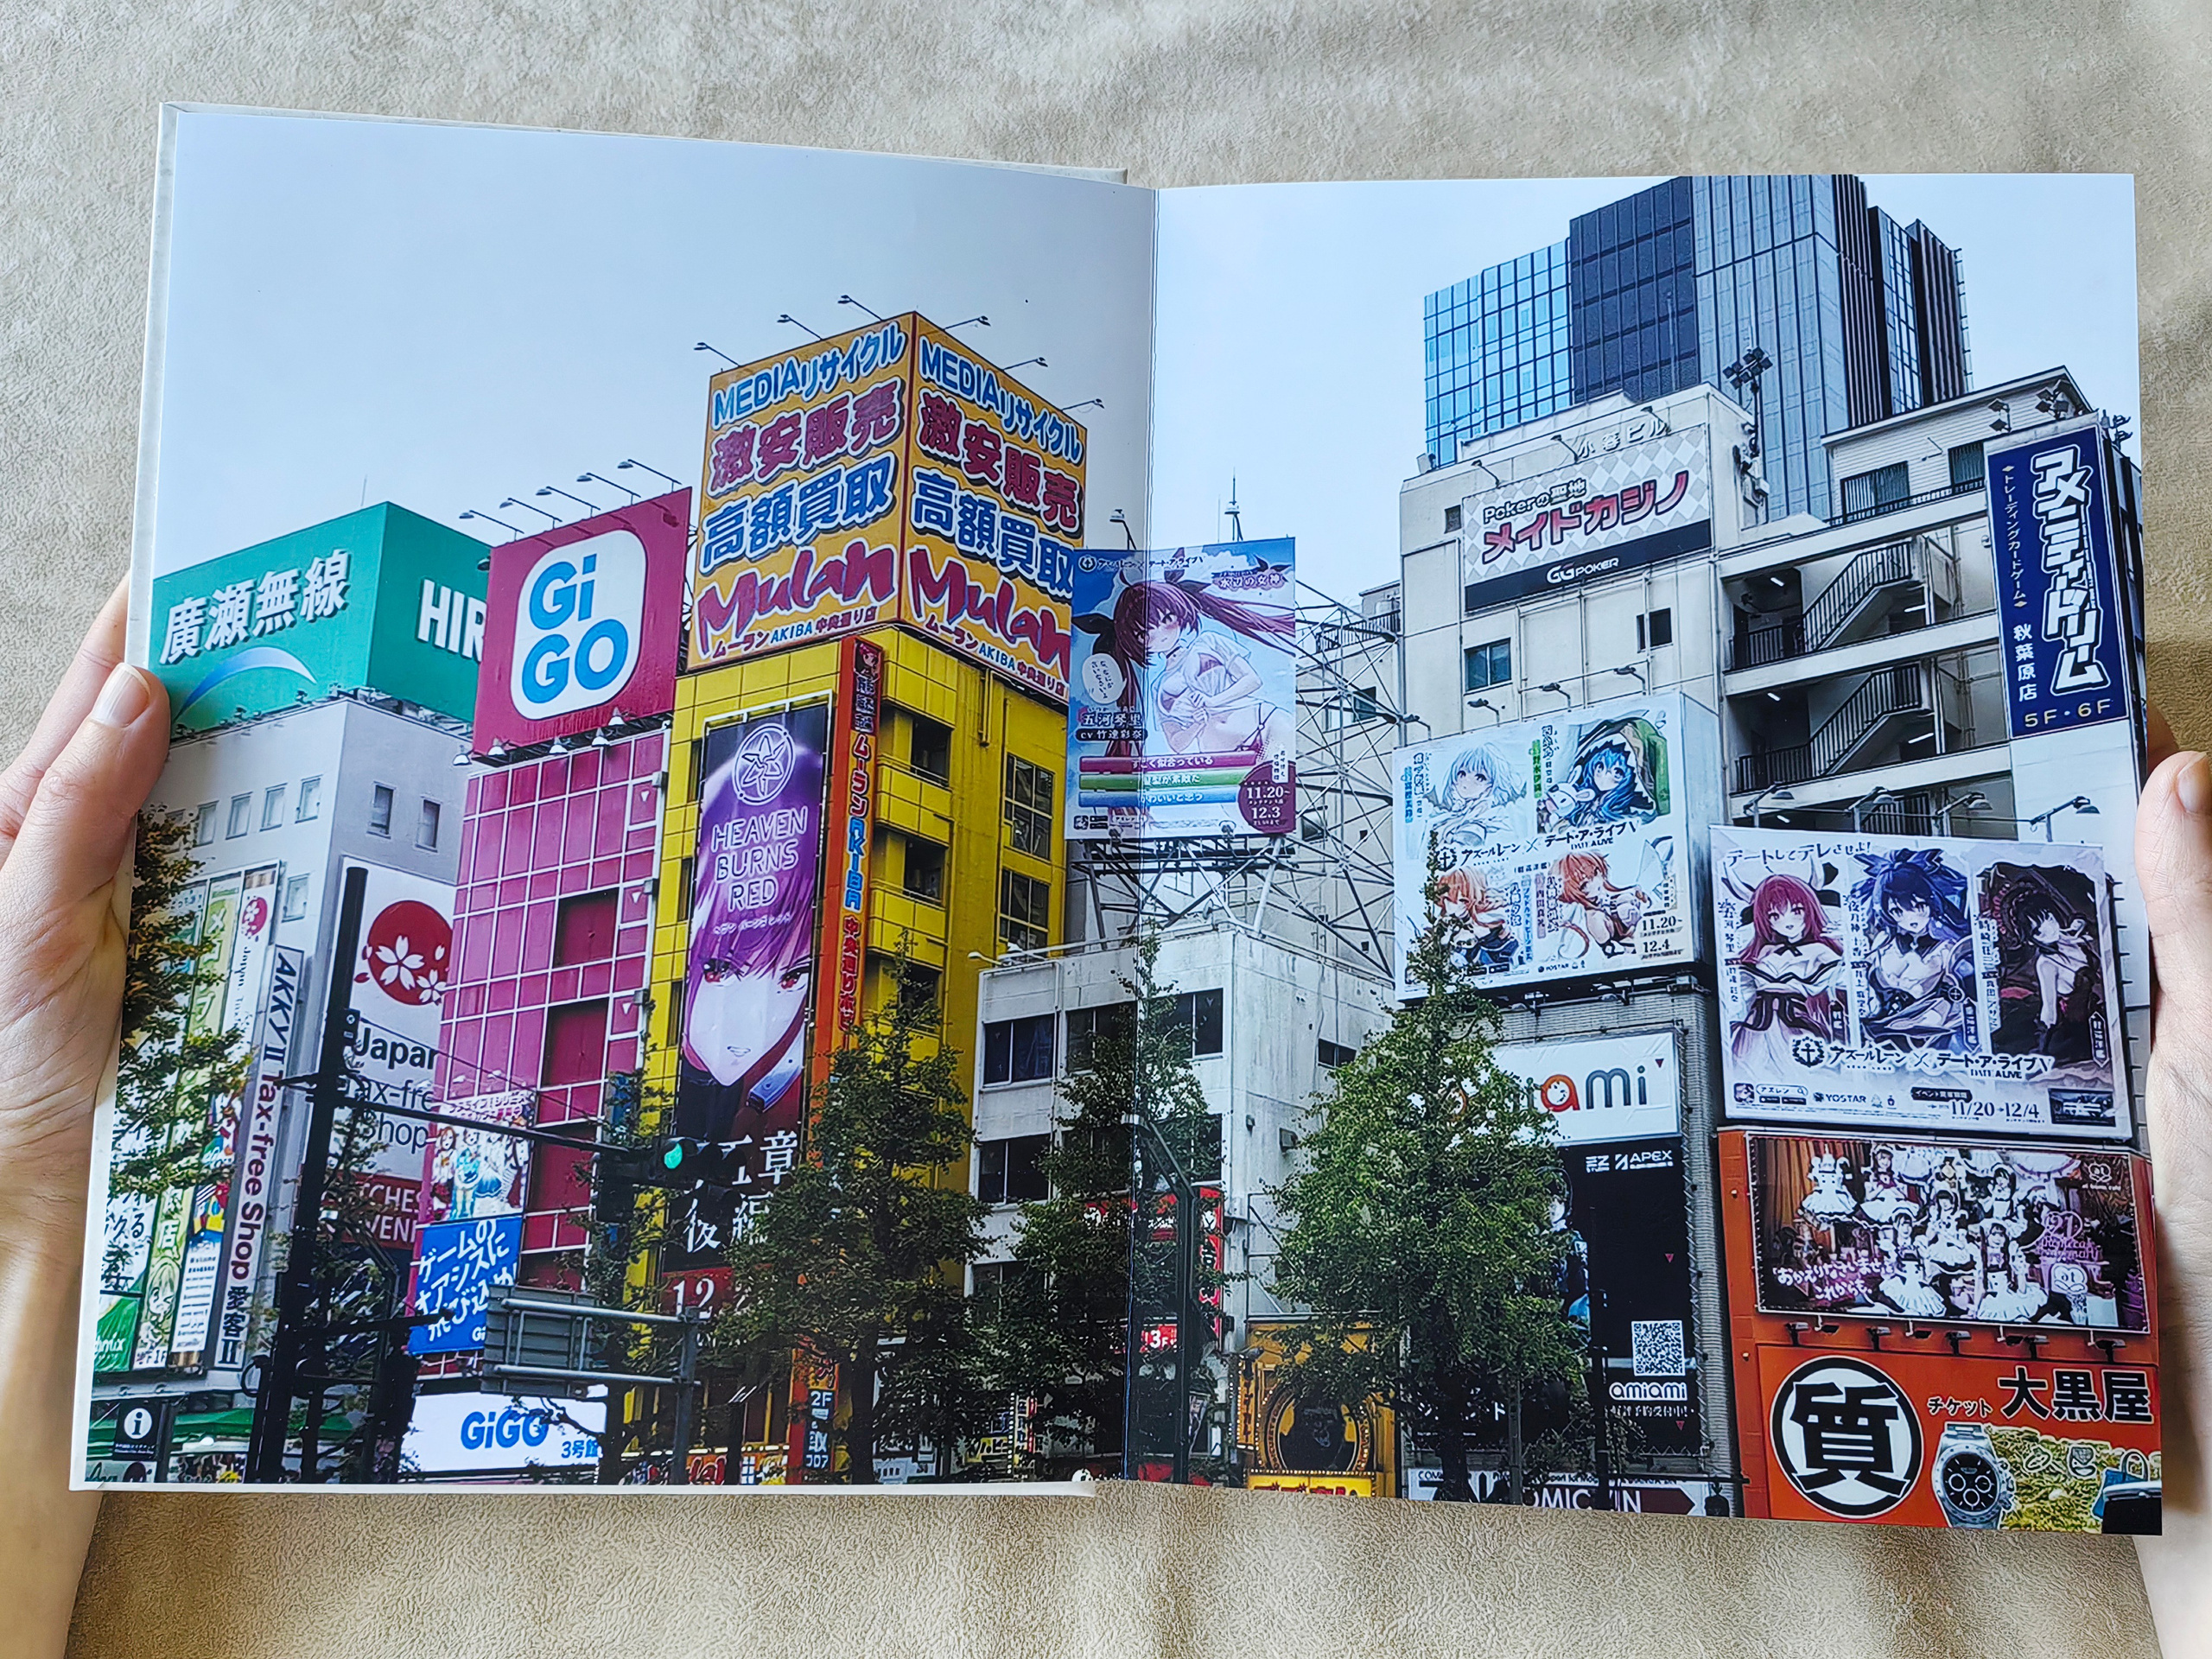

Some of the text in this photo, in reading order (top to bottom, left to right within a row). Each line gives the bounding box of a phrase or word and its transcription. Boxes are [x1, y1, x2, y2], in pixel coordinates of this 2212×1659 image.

[713, 321, 907, 429] MEDIAリサイクル
[919, 337, 1083, 464] MEDIAリサイクル
[709, 380, 900, 494] 激安販売
[918, 391, 1079, 531] 激安販売
[702, 455, 894, 572] 高額買取
[912, 469, 1073, 601] 高額買取
[1483, 471, 1688, 563] メイドカジノ
[160, 549, 350, 664] 廣瀬無線
[697, 543, 895, 657] Mulan
[2013, 623, 2037, 702] 秋葉原店
[711, 805, 809, 853] HEAVEN
[1251, 806, 1281, 819] 12.3
[715, 838, 799, 884] BURNS
[728, 878, 779, 912] RED
[269, 952, 296, 1045] AKKY
[1825, 1093, 1866, 1103] YOSTAR
[1952, 1102, 1996, 1117] 11/20
[2005, 1102, 2040, 1119] 12/4
[1630, 1150, 1673, 1163] APEX
[232, 1202, 264, 1281] Shop
[461, 1408, 550, 1451] GiGO
[810, 1390, 833, 1407] 2F
[1610, 1382, 1687, 1400] amiami
[1928, 1365, 2154, 1423] チケット 大黒屋
[1790, 1382, 1911, 1498] 質
